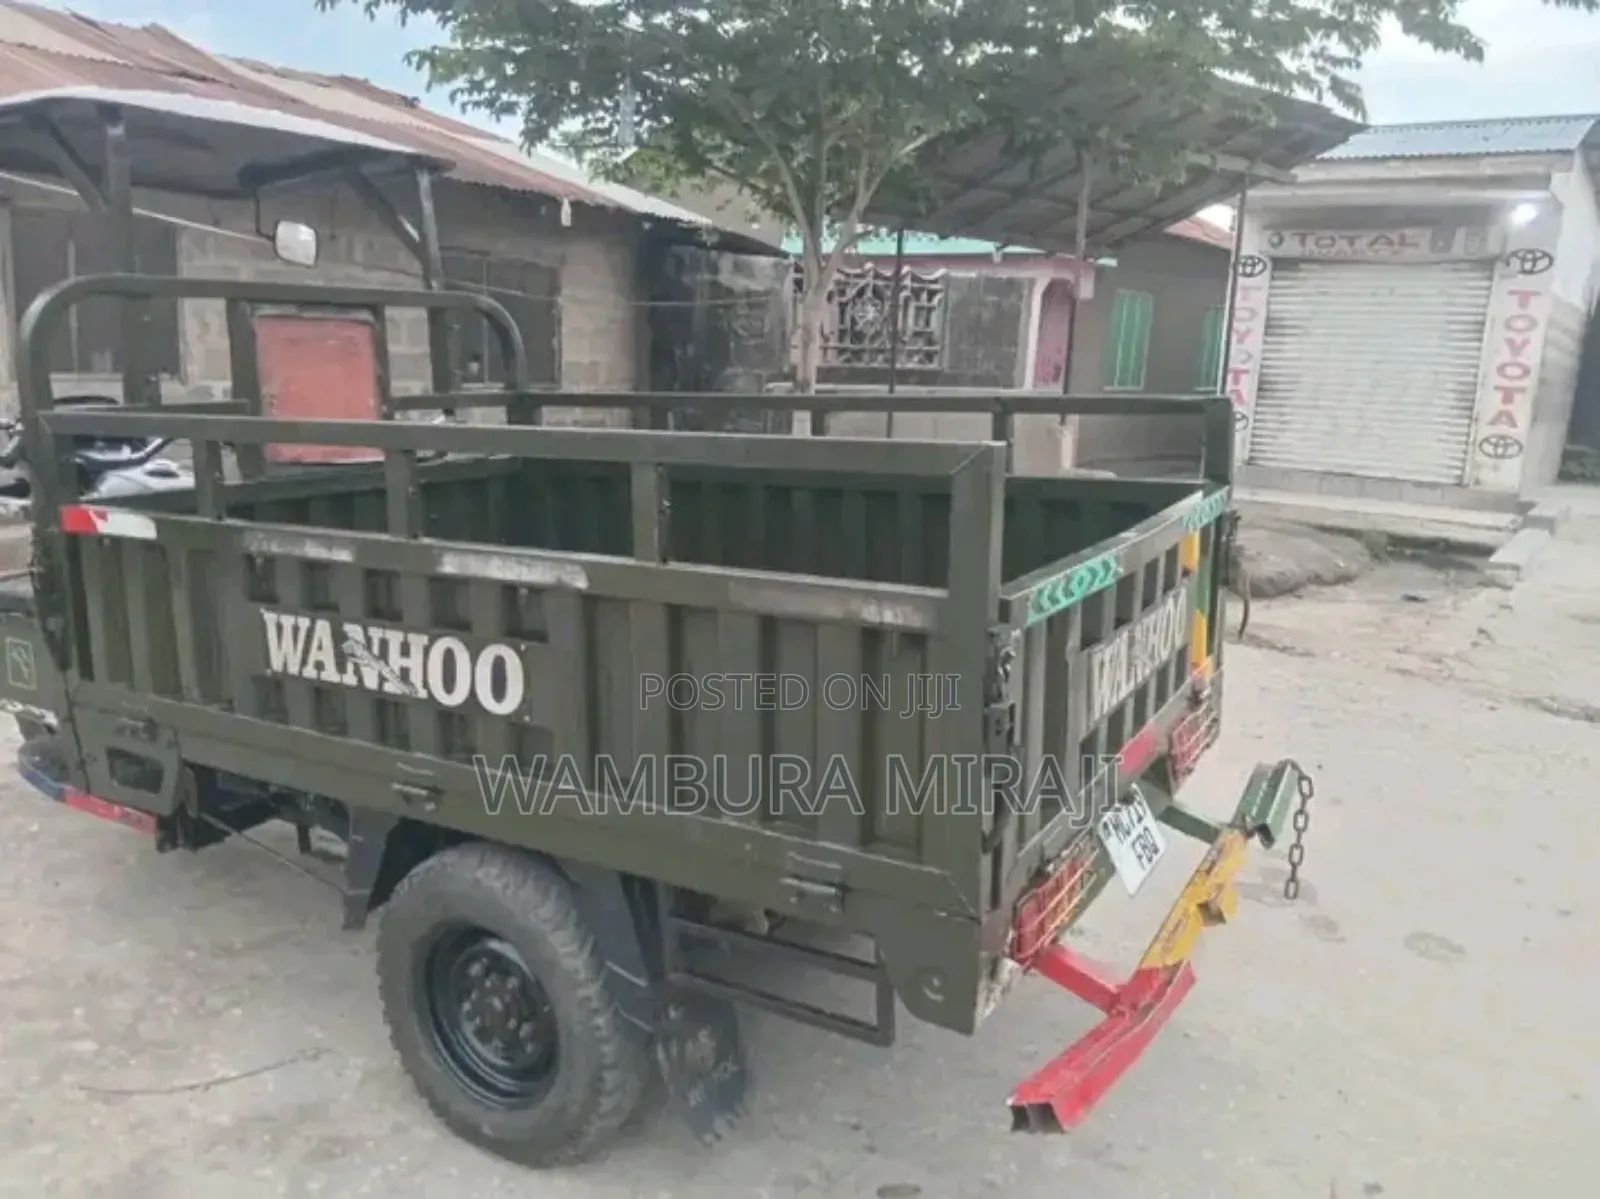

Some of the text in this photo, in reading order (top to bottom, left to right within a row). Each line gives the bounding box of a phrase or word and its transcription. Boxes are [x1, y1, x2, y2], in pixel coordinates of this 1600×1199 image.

[1292, 232, 1420, 249] TOTAL
[1486, 290, 1543, 428] TOYOTA
[261, 609, 525, 715] WANHOO
